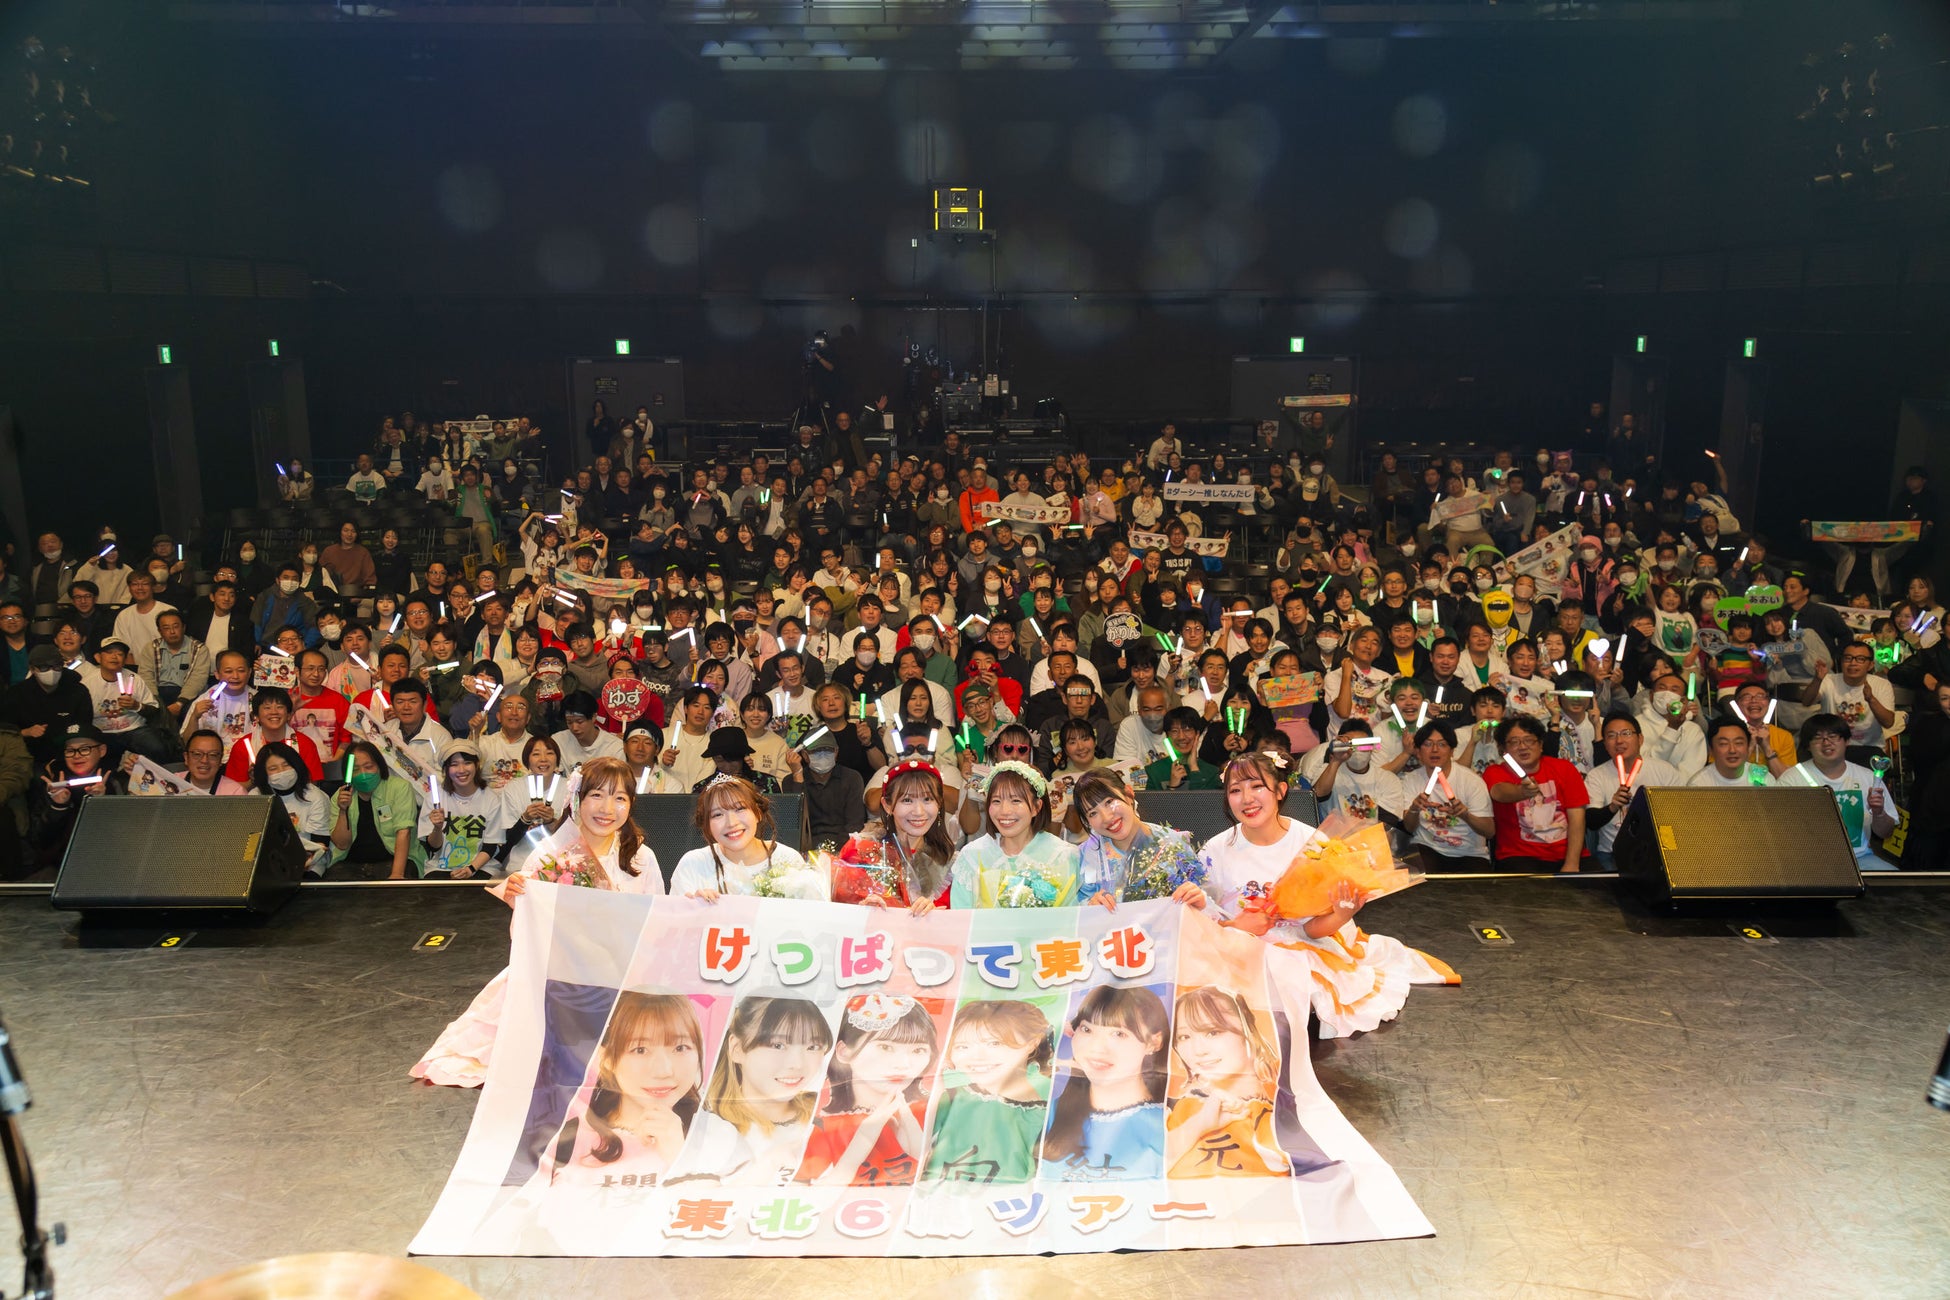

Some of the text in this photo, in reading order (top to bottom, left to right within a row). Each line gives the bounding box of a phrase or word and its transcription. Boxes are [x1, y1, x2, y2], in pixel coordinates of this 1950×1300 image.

[1749, 595, 1780, 604] あおい
[443, 811, 486, 838] 水谷
[1482, 928, 1502, 939] 2
[1743, 928, 1762, 938] 3
[161, 937, 181, 947] 3
[425, 935, 445, 946] 2
[1195, 1133, 1244, 1171] 元
